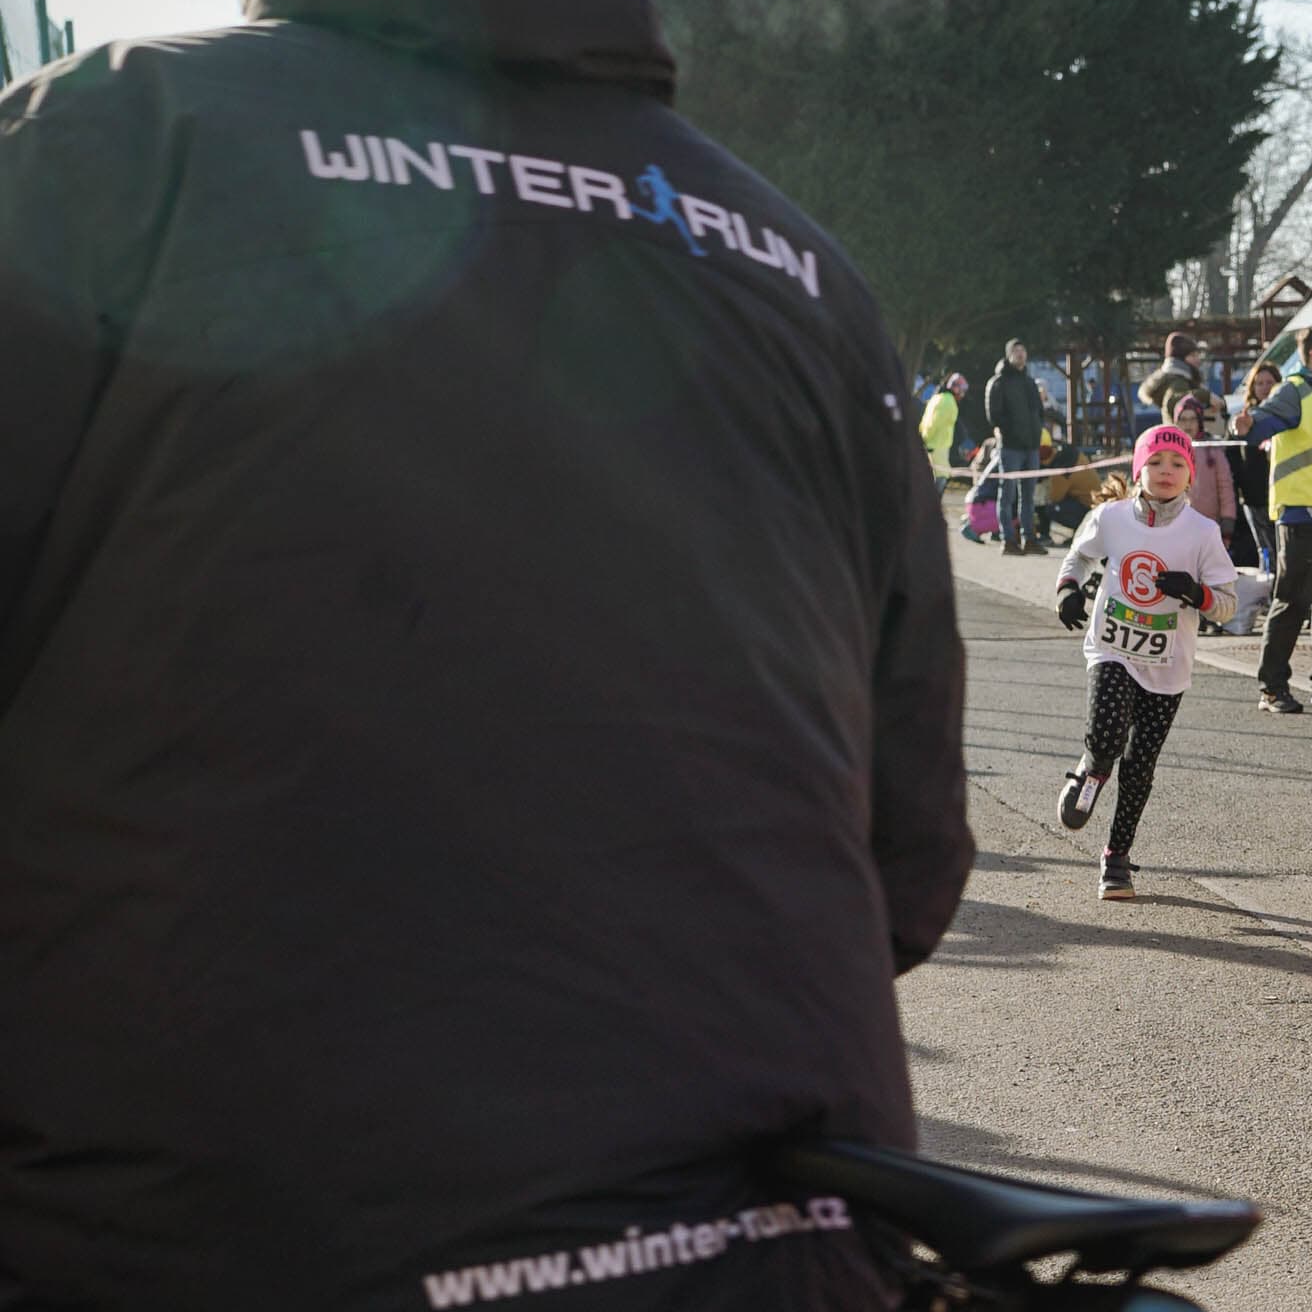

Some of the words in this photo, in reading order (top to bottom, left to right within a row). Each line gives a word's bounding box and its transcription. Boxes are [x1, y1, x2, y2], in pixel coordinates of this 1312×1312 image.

[301, 130, 632, 219] WINTER
[680, 194, 820, 297] RUN
[1101, 617, 1167, 656] 3179
[422, 1197, 853, 1310] www.winter-run.cz
